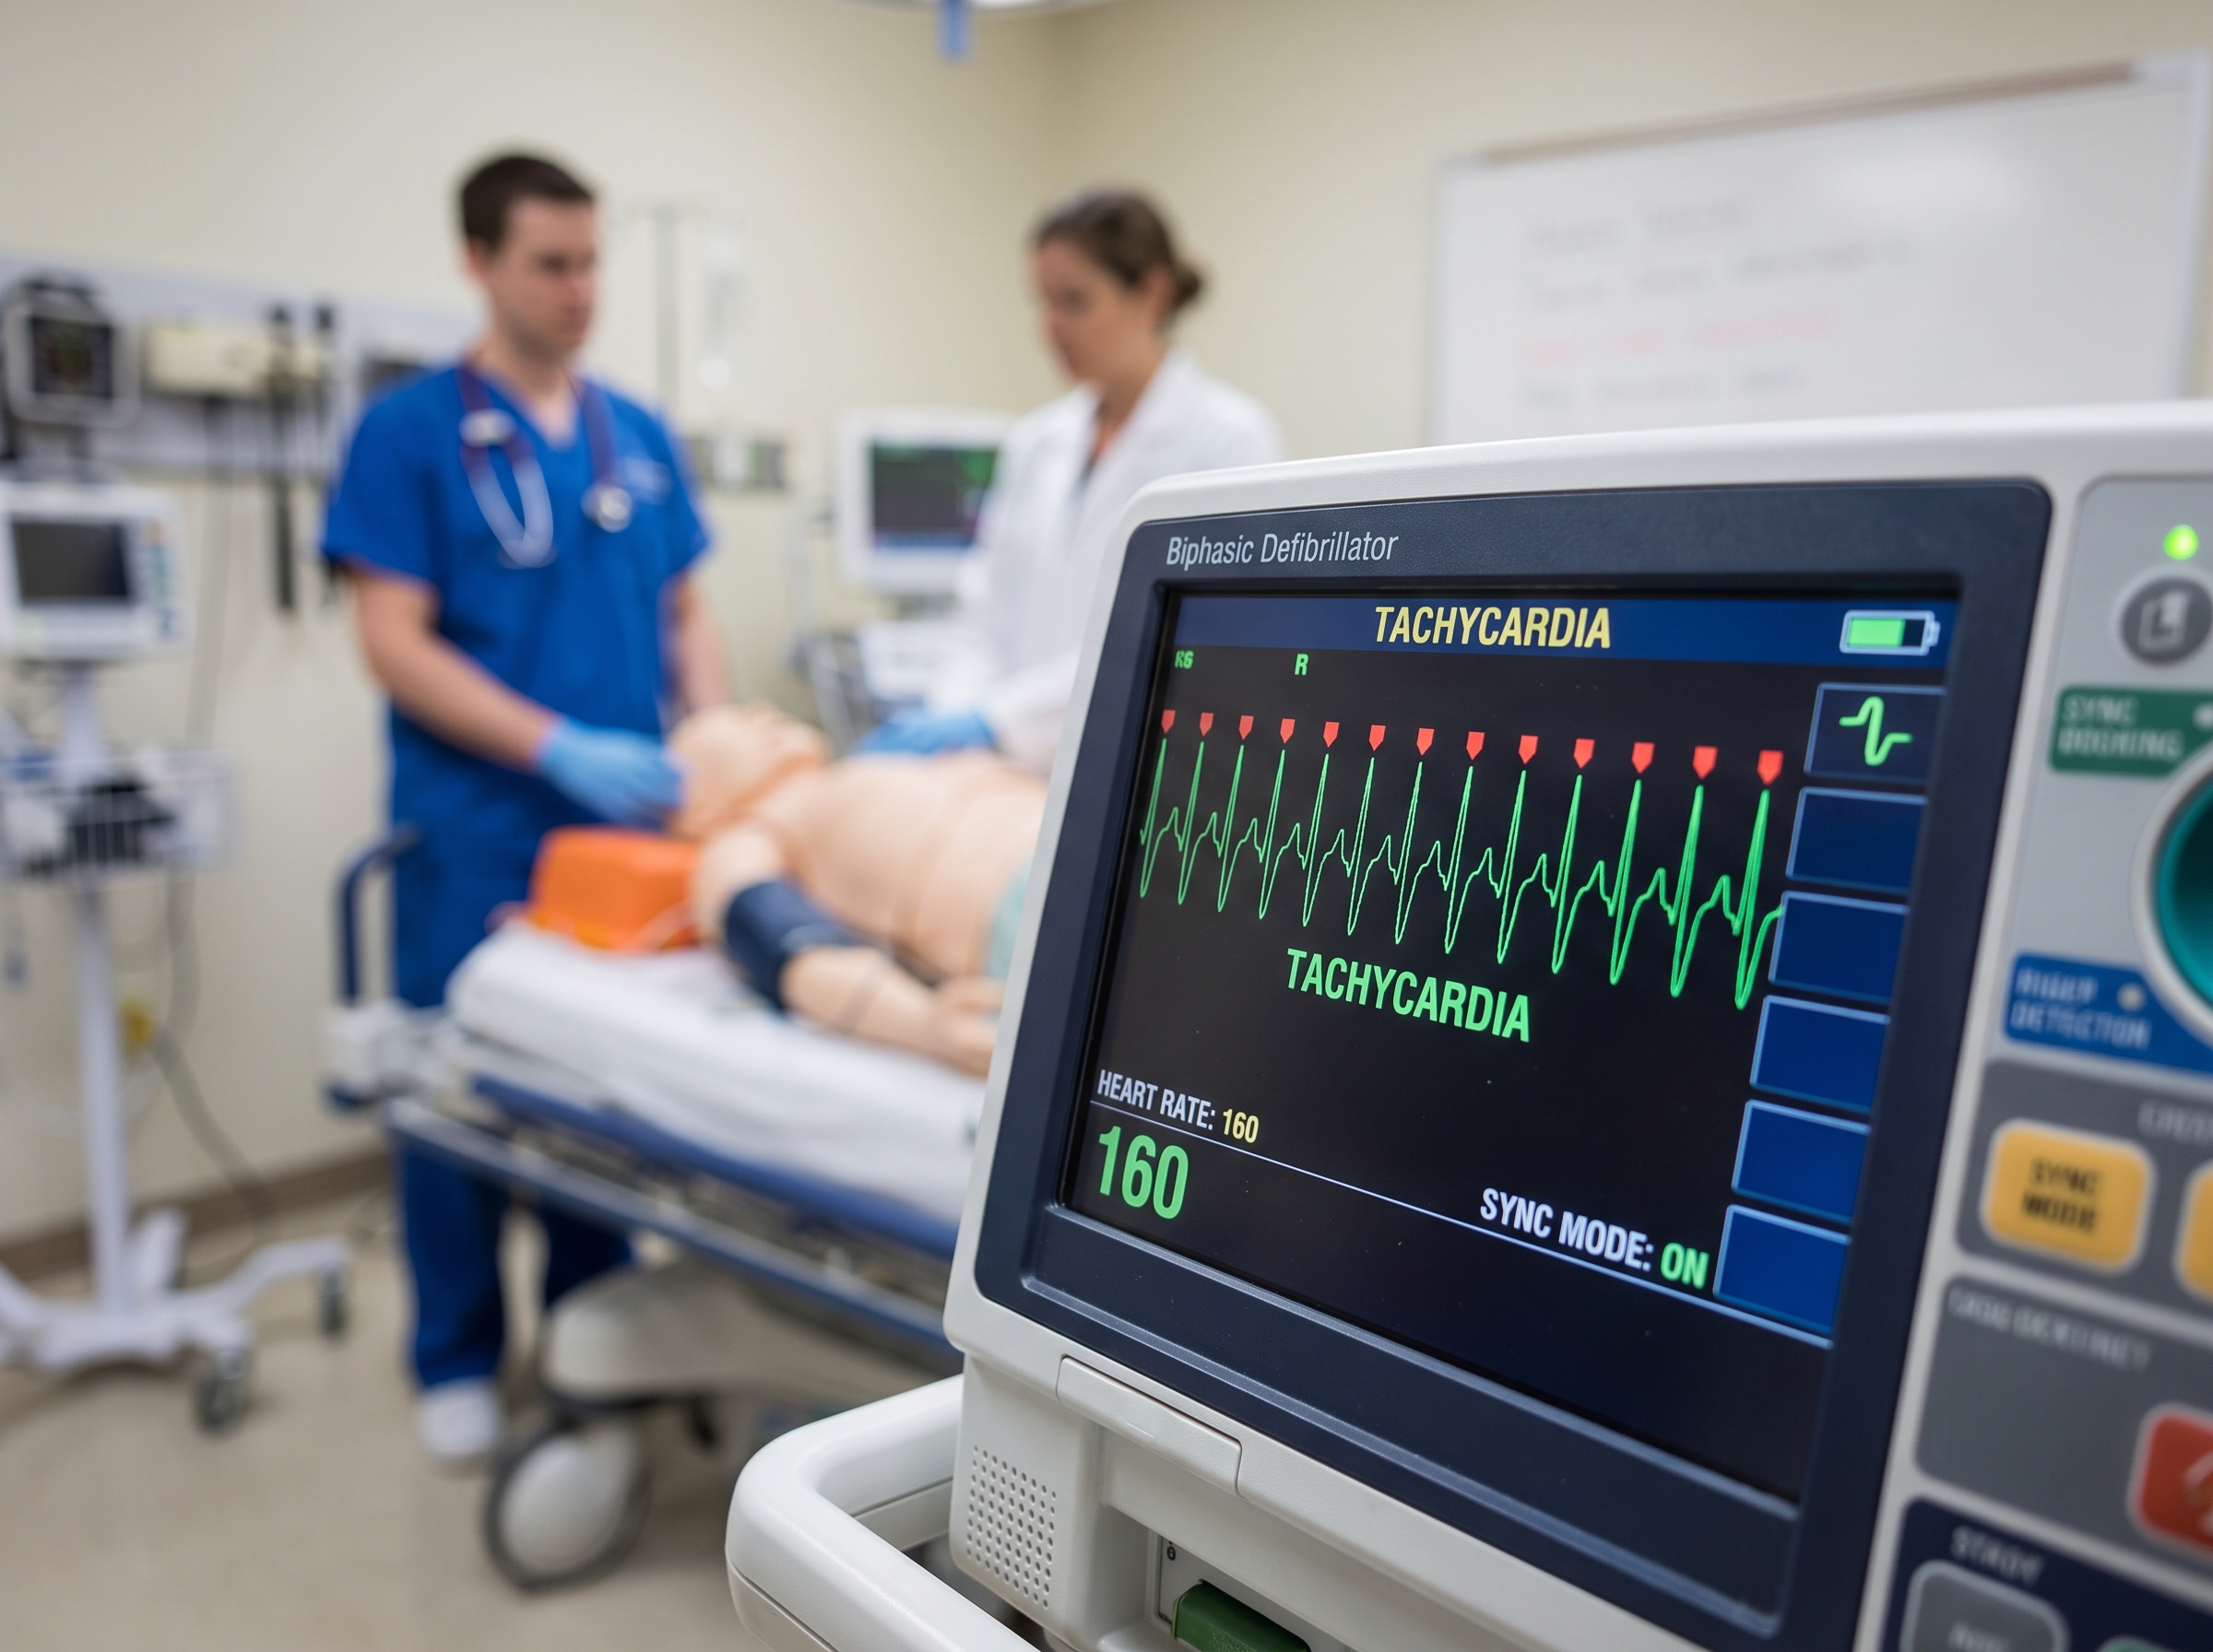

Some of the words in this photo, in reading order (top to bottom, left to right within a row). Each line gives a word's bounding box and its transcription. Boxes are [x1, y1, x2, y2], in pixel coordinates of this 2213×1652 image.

[1166, 534, 1254, 572] Biphasic
[1260, 530, 1400, 564] Defibrillator
[1294, 653, 1309, 676] R
[1375, 606, 1611, 649] TACHYCARDIA
[1286, 948, 1531, 1043] TACHYCARDIA
[1096, 1068, 1159, 1111] HEART
[1159, 1087, 1217, 1131] RATE:
[1222, 1107, 1260, 1144] 160
[1097, 1126, 1189, 1220] 160
[1479, 1186, 1554, 1238] SYNC
[1557, 1210, 1655, 1272] MODE:
[1660, 1242, 1710, 1289] ON
